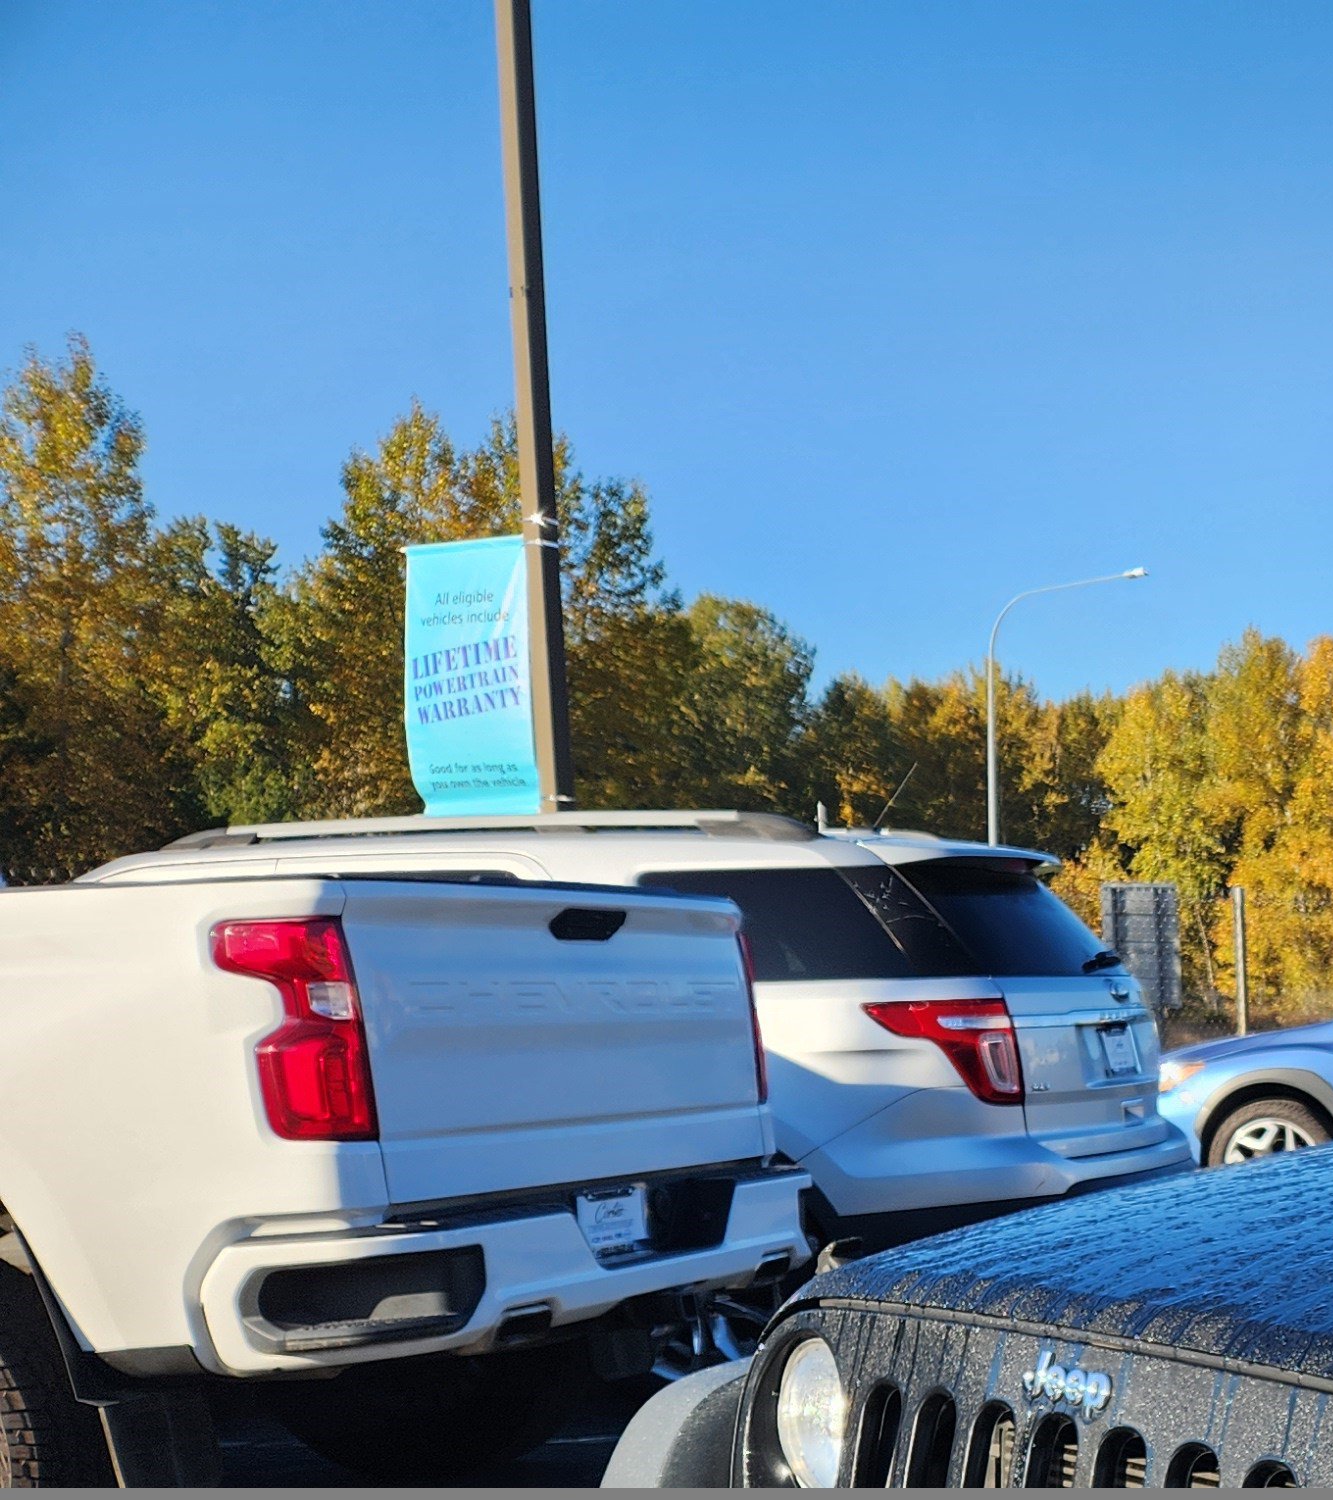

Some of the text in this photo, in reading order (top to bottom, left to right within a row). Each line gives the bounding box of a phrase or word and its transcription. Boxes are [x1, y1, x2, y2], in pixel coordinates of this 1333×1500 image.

[420, 608, 510, 627] vehicles include
[435, 588, 495, 608] All eligible
[411, 634, 518, 680] LIFETIME
[414, 663, 520, 702] POWERTRAIN
[417, 685, 521, 726] WARRANTY
[429, 762, 452, 774] Good
[454, 762, 468, 773] for
[1023, 1351, 1113, 1419] Jeep
